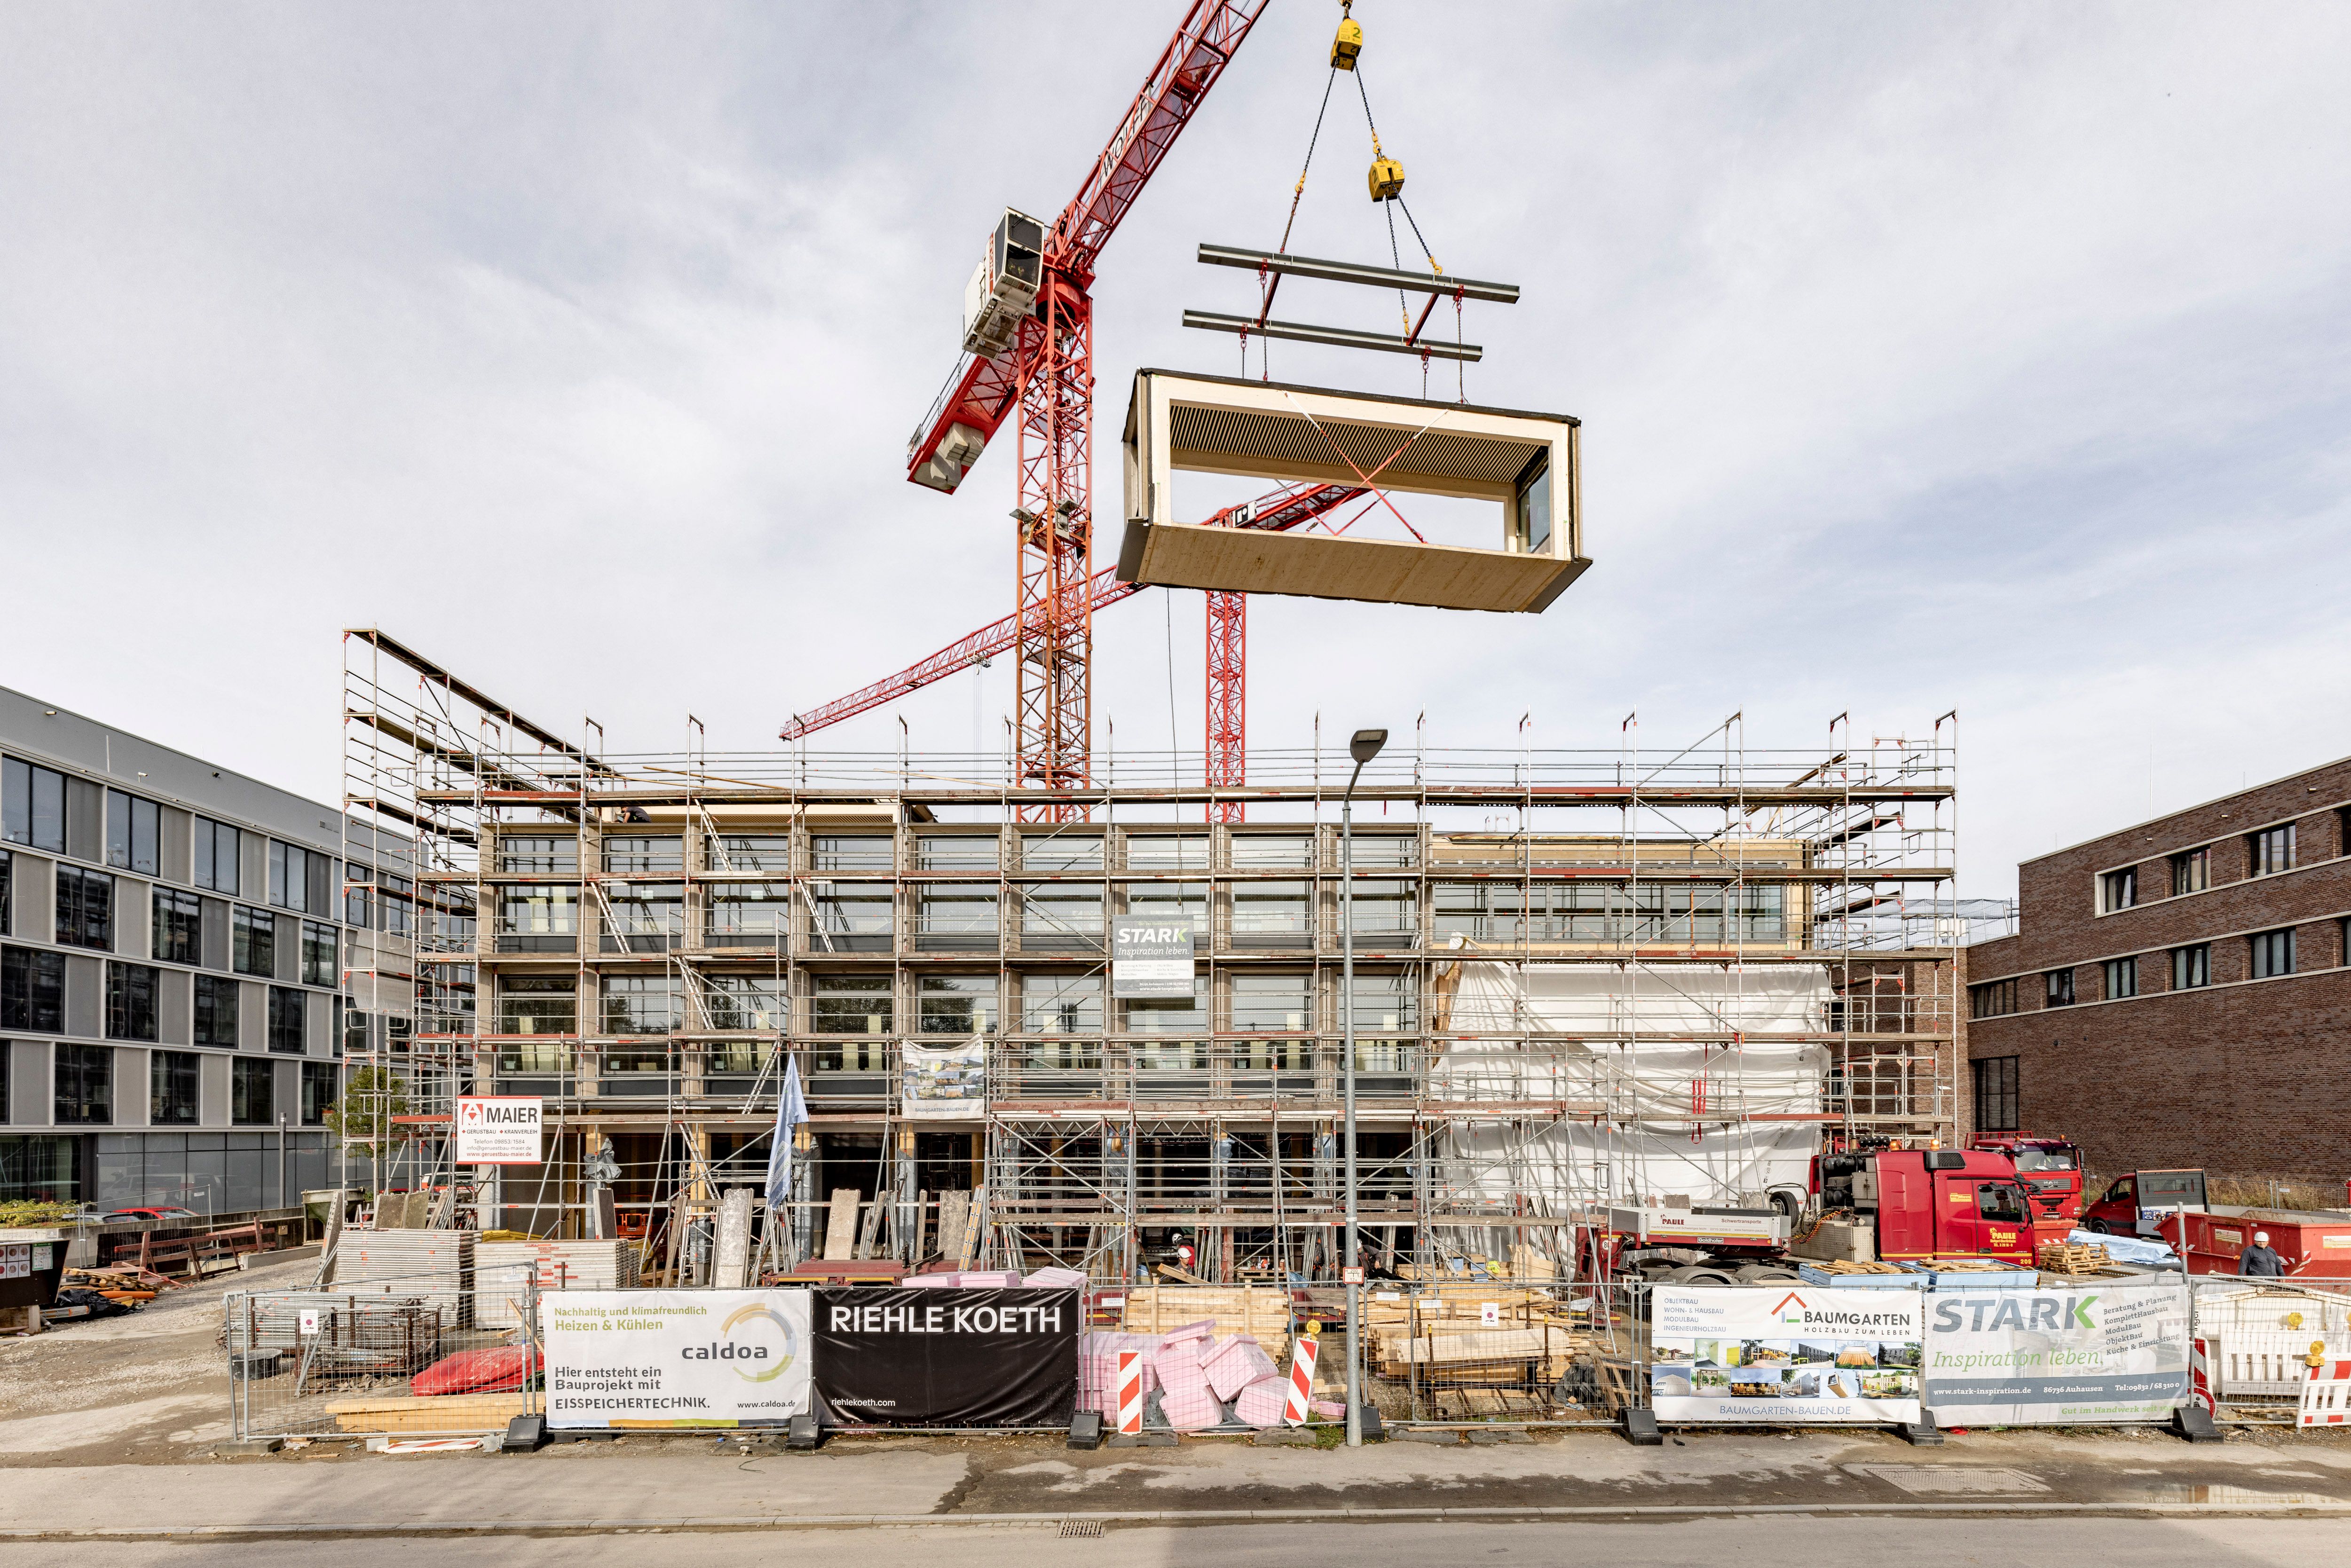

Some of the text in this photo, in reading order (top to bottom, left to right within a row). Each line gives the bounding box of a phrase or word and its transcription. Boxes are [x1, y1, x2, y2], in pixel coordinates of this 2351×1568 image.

[1353, 27, 1360, 39] 2
[1118, 928, 1189, 943] STARK
[1118, 946, 1190, 957] Inspiration leben.
[487, 1107, 537, 1123] MAIER
[2103, 1303, 2136, 1315] Beratung
[2145, 1293, 2177, 1306] Planung
[554, 1306, 707, 1318] Nachhaltig und klimafreundlich
[1805, 1311, 1910, 1325] BAUMGARTEN
[1932, 1296, 2099, 1332] STARK
[2104, 1305, 2169, 1325] KomplettHausbau
[555, 1318, 663, 1331] Heizen & Kühlen
[831, 1306, 1060, 1333] RIEHLE KOETH
[2105, 1322, 2142, 1335] ModulBau
[2106, 1332, 2143, 1346] ObjektBau
[2106, 1345, 2129, 1355] Küche
[2138, 1333, 2180, 1348] Einrichtung
[682, 1342, 768, 1360] caldoa
[1933, 1348, 2104, 1372] Inspiration leben.
[555, 1366, 662, 1378] Hier entsteht ein
[555, 1379, 661, 1392] Bauprojekt mit
[1933, 1386, 2031, 1396] www.stark-inspiration.de
[555, 1397, 710, 1409] EISSPEICHERTECHNIK.
[831, 1398, 896, 1407] riehlekoeth.com
[1720, 1405, 1851, 1415] BAUMGARTEN-BAUEN.DE
